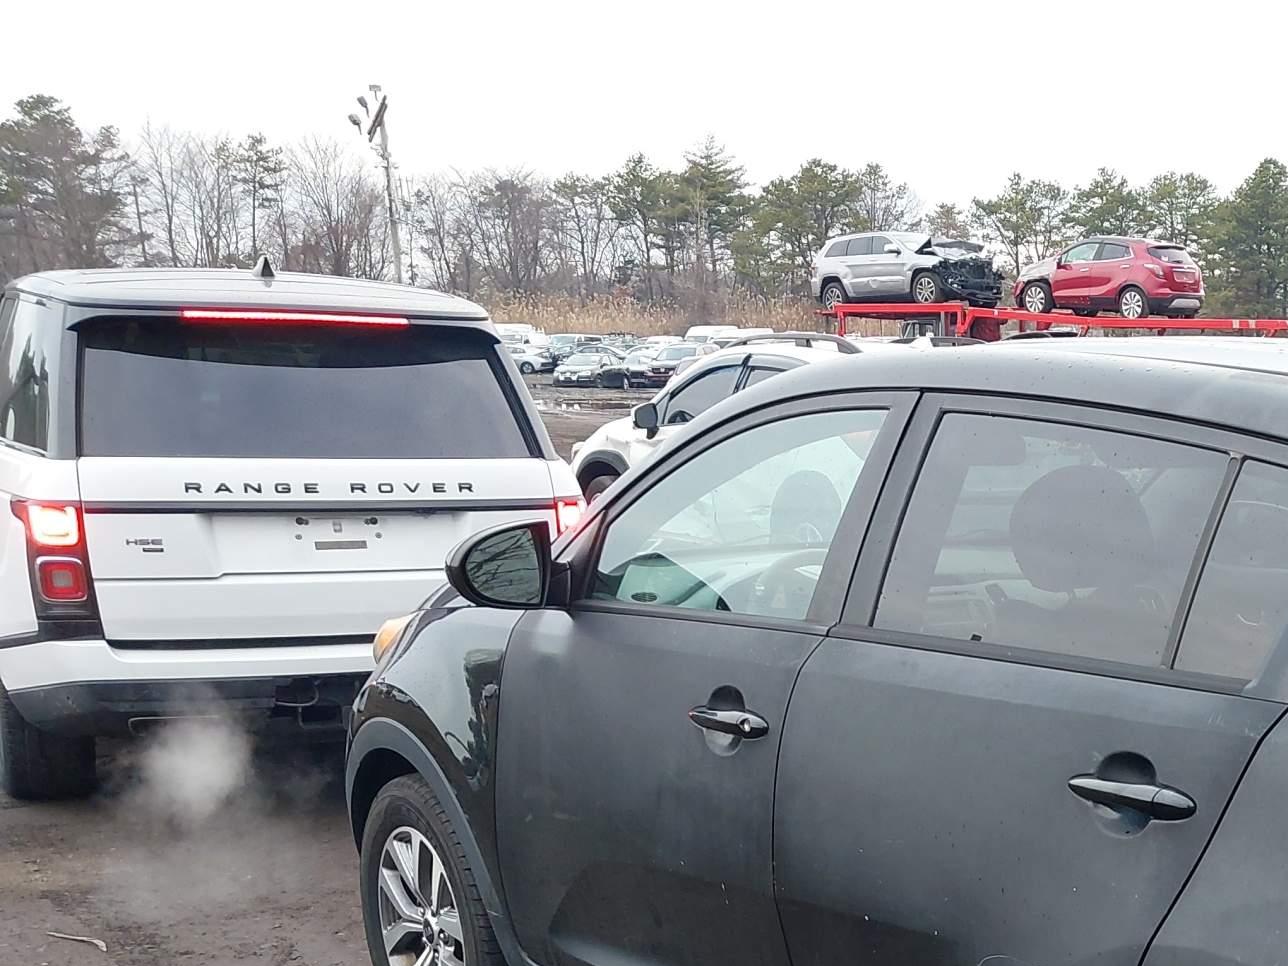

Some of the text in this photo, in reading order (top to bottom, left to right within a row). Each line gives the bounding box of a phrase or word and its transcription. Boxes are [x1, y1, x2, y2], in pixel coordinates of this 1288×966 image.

[184, 482, 474, 494] RANGE ROVER
[126, 538, 163, 546] HSE
